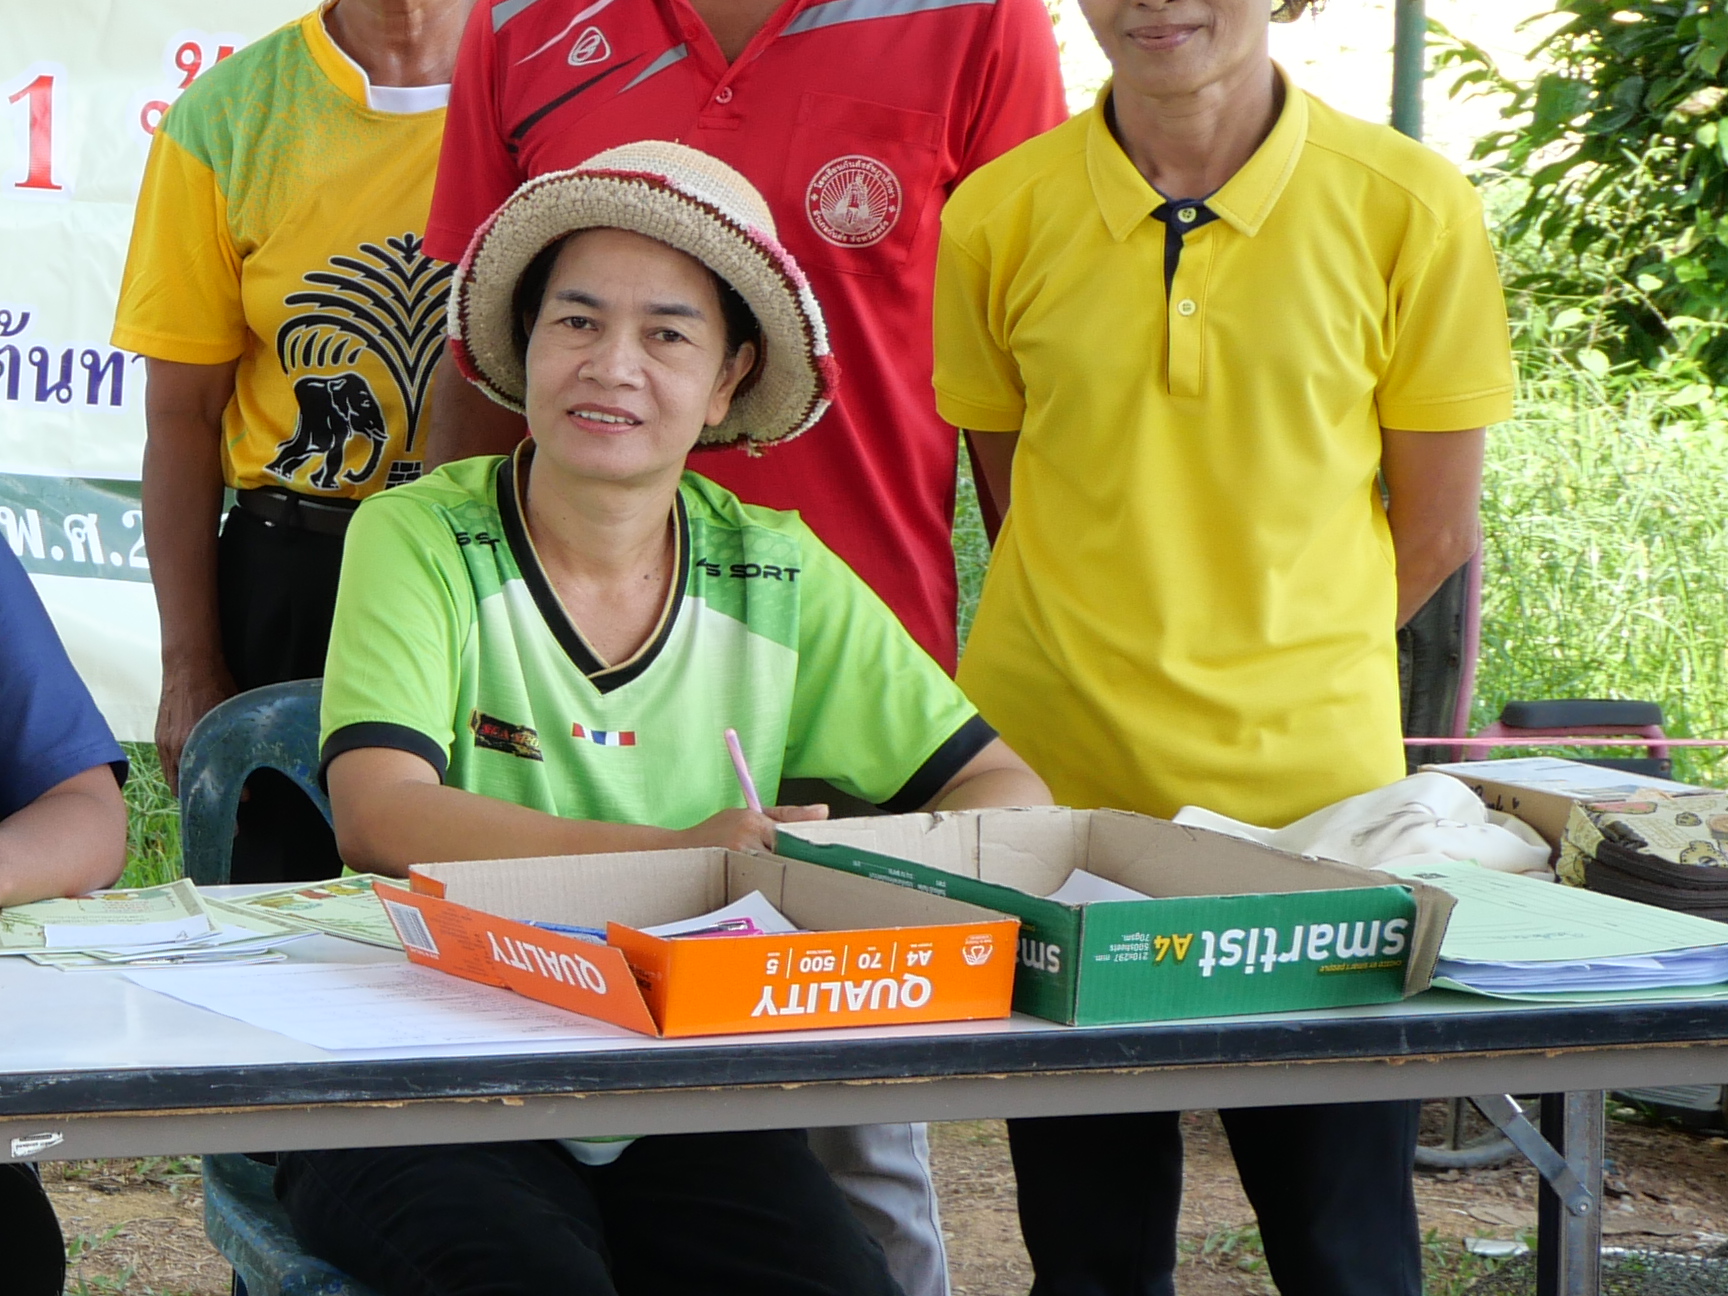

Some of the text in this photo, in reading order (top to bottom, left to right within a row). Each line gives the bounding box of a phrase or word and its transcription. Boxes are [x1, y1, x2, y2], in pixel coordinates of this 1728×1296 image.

[7, 74, 63, 191] 1
[486, 930, 608, 995] QUALITY
[766, 949, 933, 975] A4 70 500 5
[1153, 917, 1409, 978] smartist A4
[750, 973, 933, 1017] QUALITY
